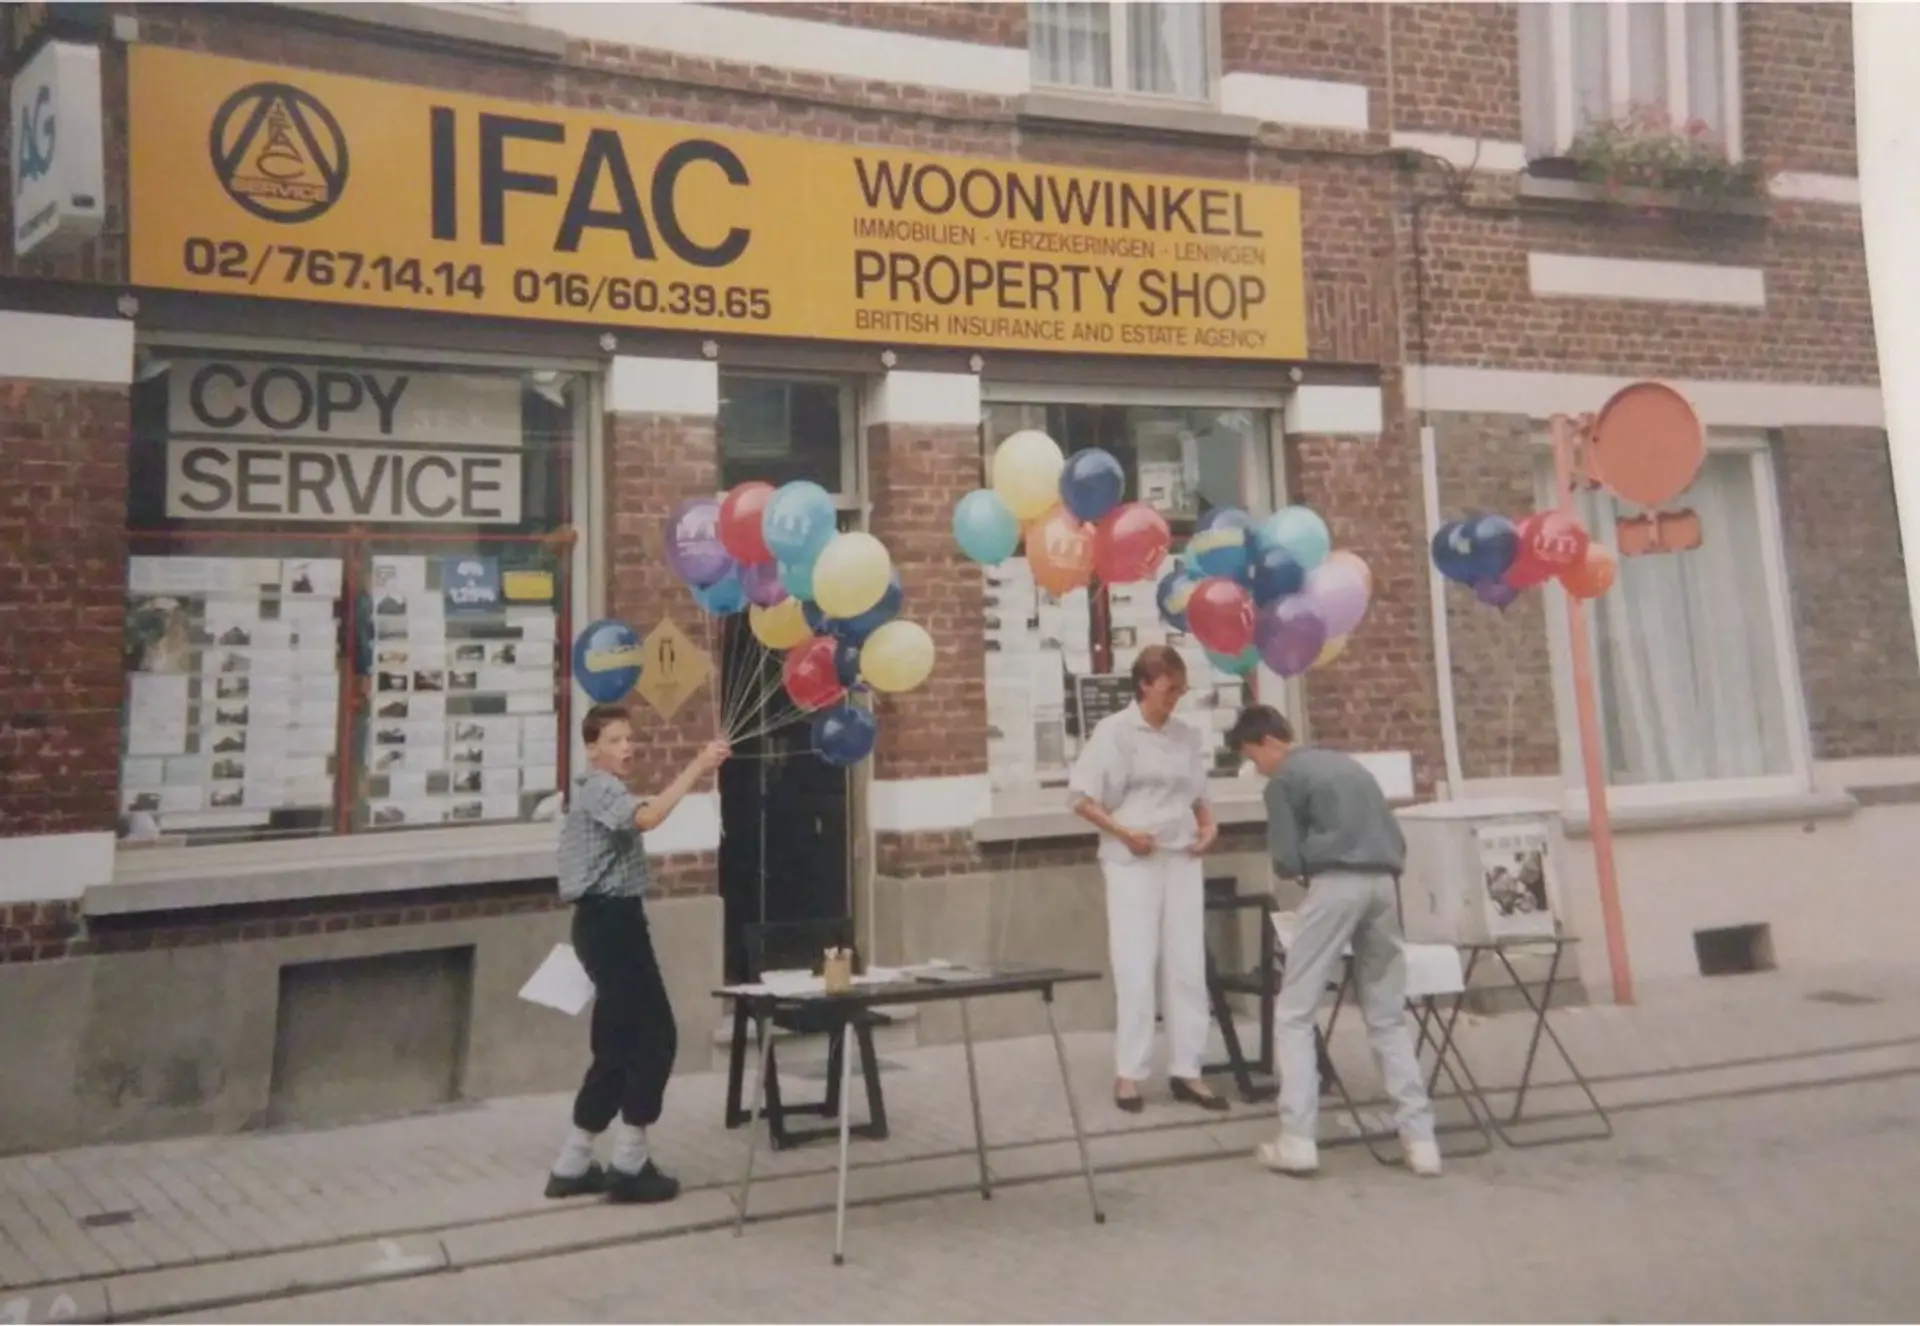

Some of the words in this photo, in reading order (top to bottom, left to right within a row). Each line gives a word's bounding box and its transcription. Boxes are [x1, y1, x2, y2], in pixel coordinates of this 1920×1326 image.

[430, 105, 751, 268] IFAC
[853, 157, 1263, 238] WOONWINKEL
[183, 236, 485, 299] 02/767.14.14
[853, 217, 975, 246] IMMOBILIEN
[995, 228, 1154, 259] VERZEKERINGEN
[1174, 242, 1266, 266] LENINGEN
[512, 268, 772, 320] 016/60.39.65
[853, 248, 1123, 314] PROPERTY
[1137, 268, 1266, 322] SHOP
[855, 308, 939, 334] BRITISH
[948, 315, 1065, 341] INSURANCE
[1071, 321, 1114, 343] AND
[1120, 324, 1188, 346] ESTATE
[1194, 327, 1268, 350] AGENCY
[189, 362, 409, 435] COPY
[179, 447, 503, 519] SERVICE
